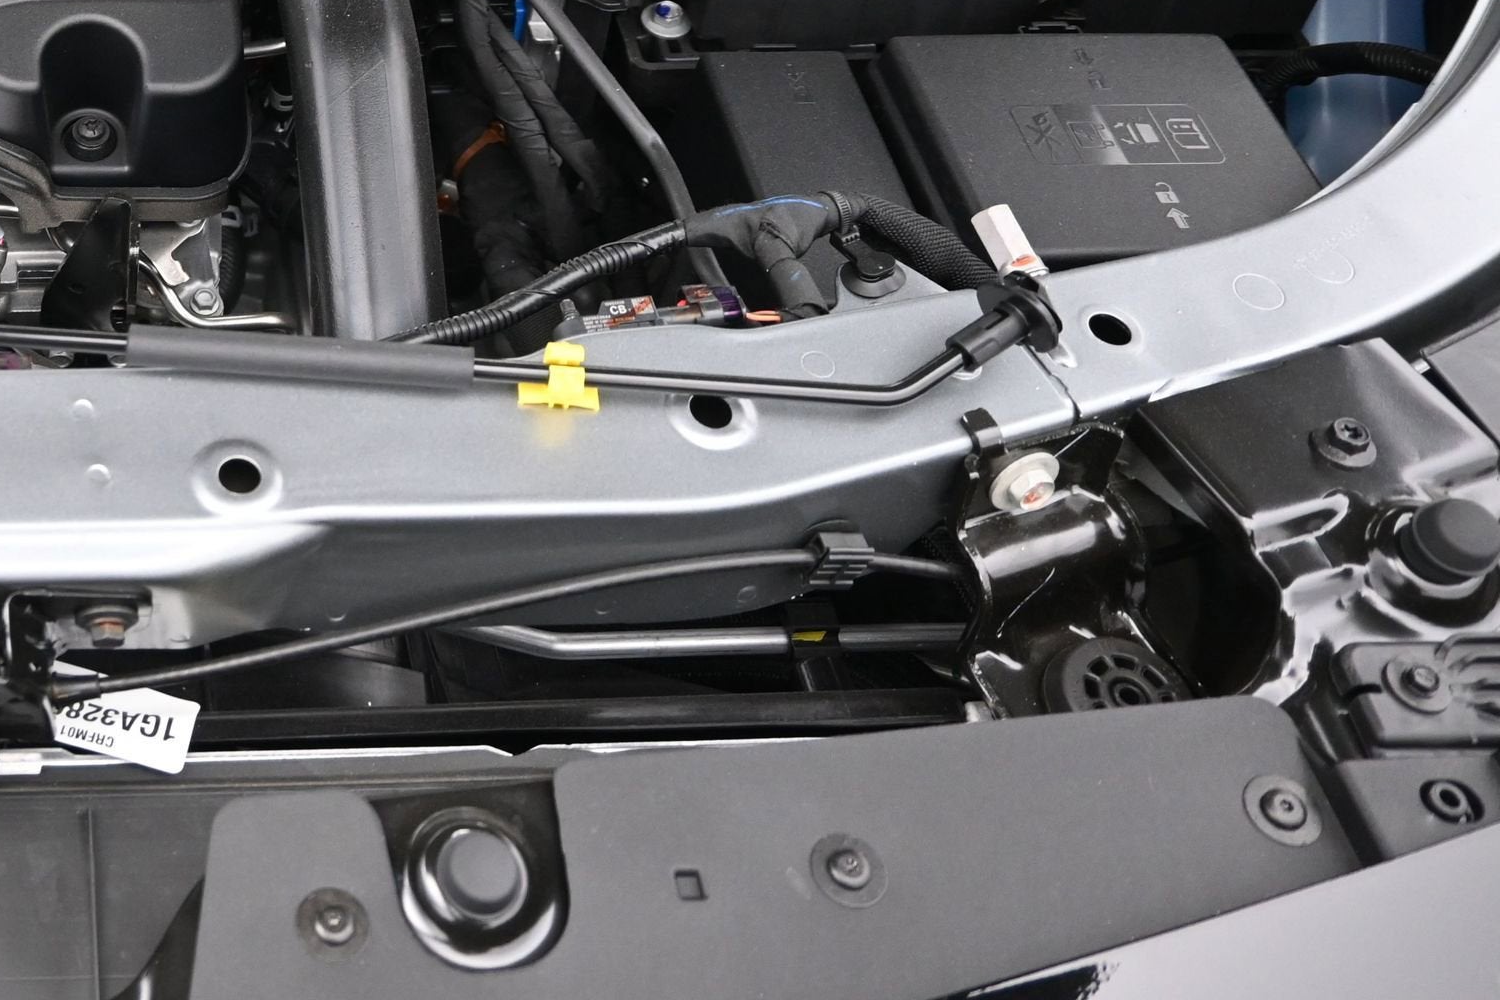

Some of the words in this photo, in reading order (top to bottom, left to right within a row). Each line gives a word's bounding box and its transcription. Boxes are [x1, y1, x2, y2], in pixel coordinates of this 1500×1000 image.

[609, 304, 627, 315] CB
[54, 700, 176, 742] 1GA328
[60, 724, 115, 748] CRFM01
